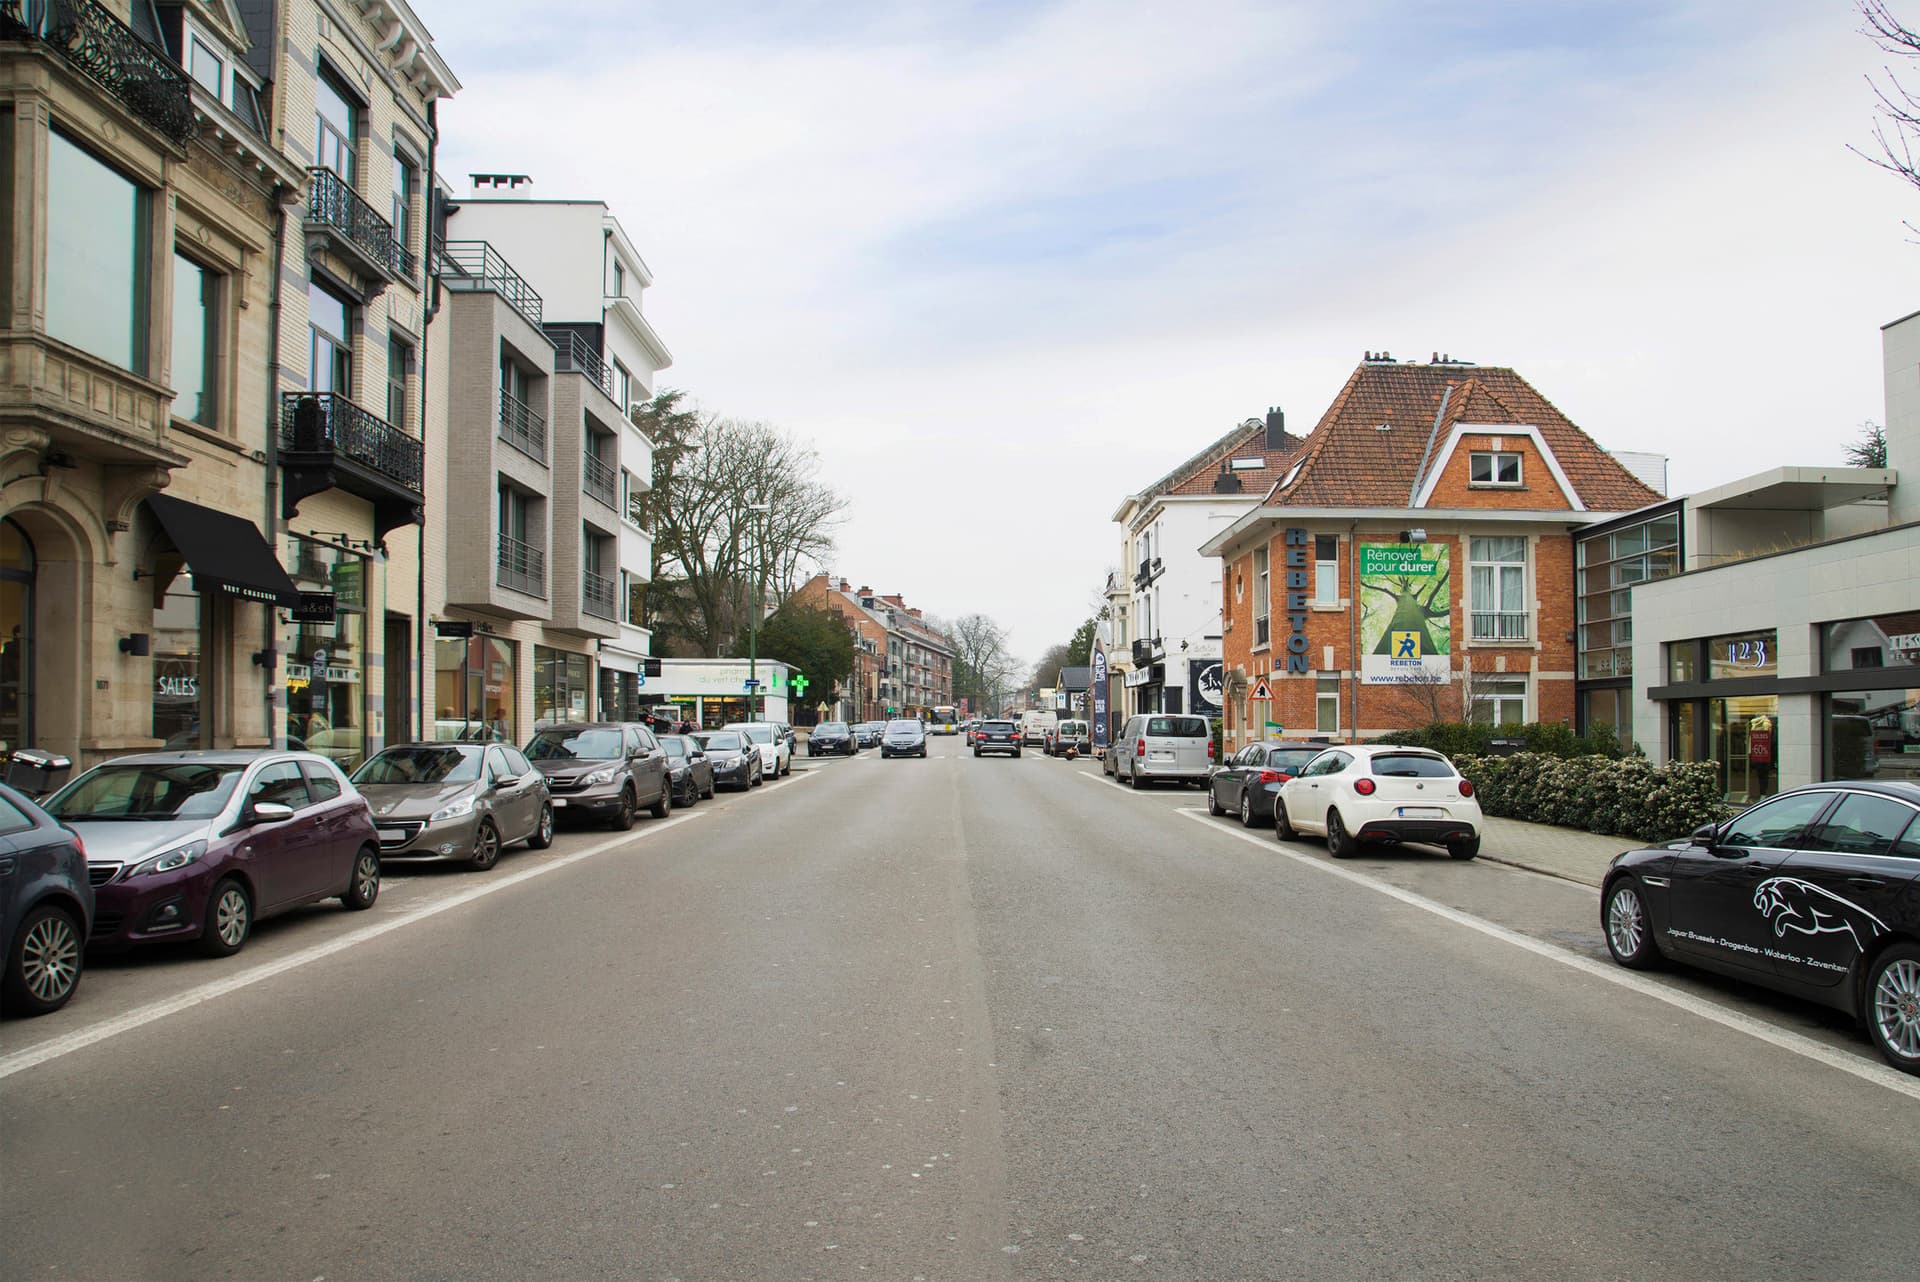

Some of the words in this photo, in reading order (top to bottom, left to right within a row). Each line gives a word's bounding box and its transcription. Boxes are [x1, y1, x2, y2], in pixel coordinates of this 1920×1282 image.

[1367, 562, 1396, 574] pour
[1399, 561, 1434, 572] durer
[1286, 528, 1309, 673] REBETON
[296, 602, 332, 613] a&sh
[1390, 659, 1423, 667] REBETON
[1370, 674, 1442, 683] www.rebeton.be
[159, 676, 197, 696] SALES
[1667, 927, 1688, 938] Jaguar
[1688, 931, 1715, 944] Brussels
[1720, 938, 1759, 954] Drogenbos
[1764, 948, 1801, 963] Waterloo
[1807, 957, 1850, 974] Zaventem
